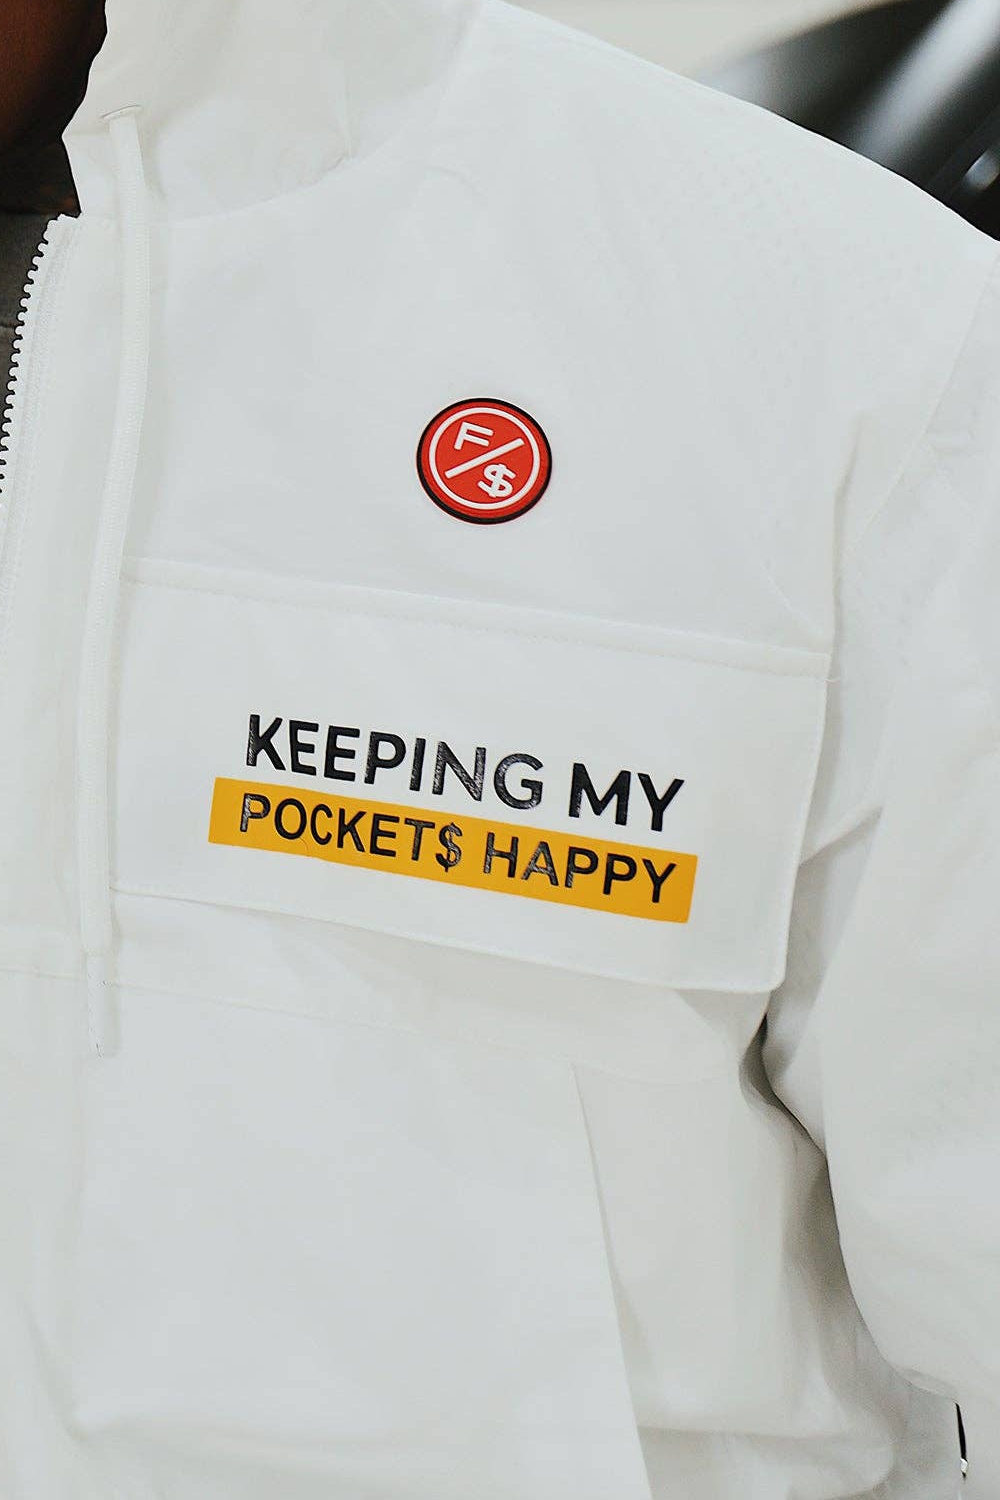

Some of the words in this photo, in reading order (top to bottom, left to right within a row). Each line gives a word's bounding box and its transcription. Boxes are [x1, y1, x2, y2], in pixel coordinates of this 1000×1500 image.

[246, 714, 543, 810] KEEPING
[568, 763, 685, 832] MY
[239, 793, 462, 872] POCKET$
[482, 832, 676, 904] HAPPY
